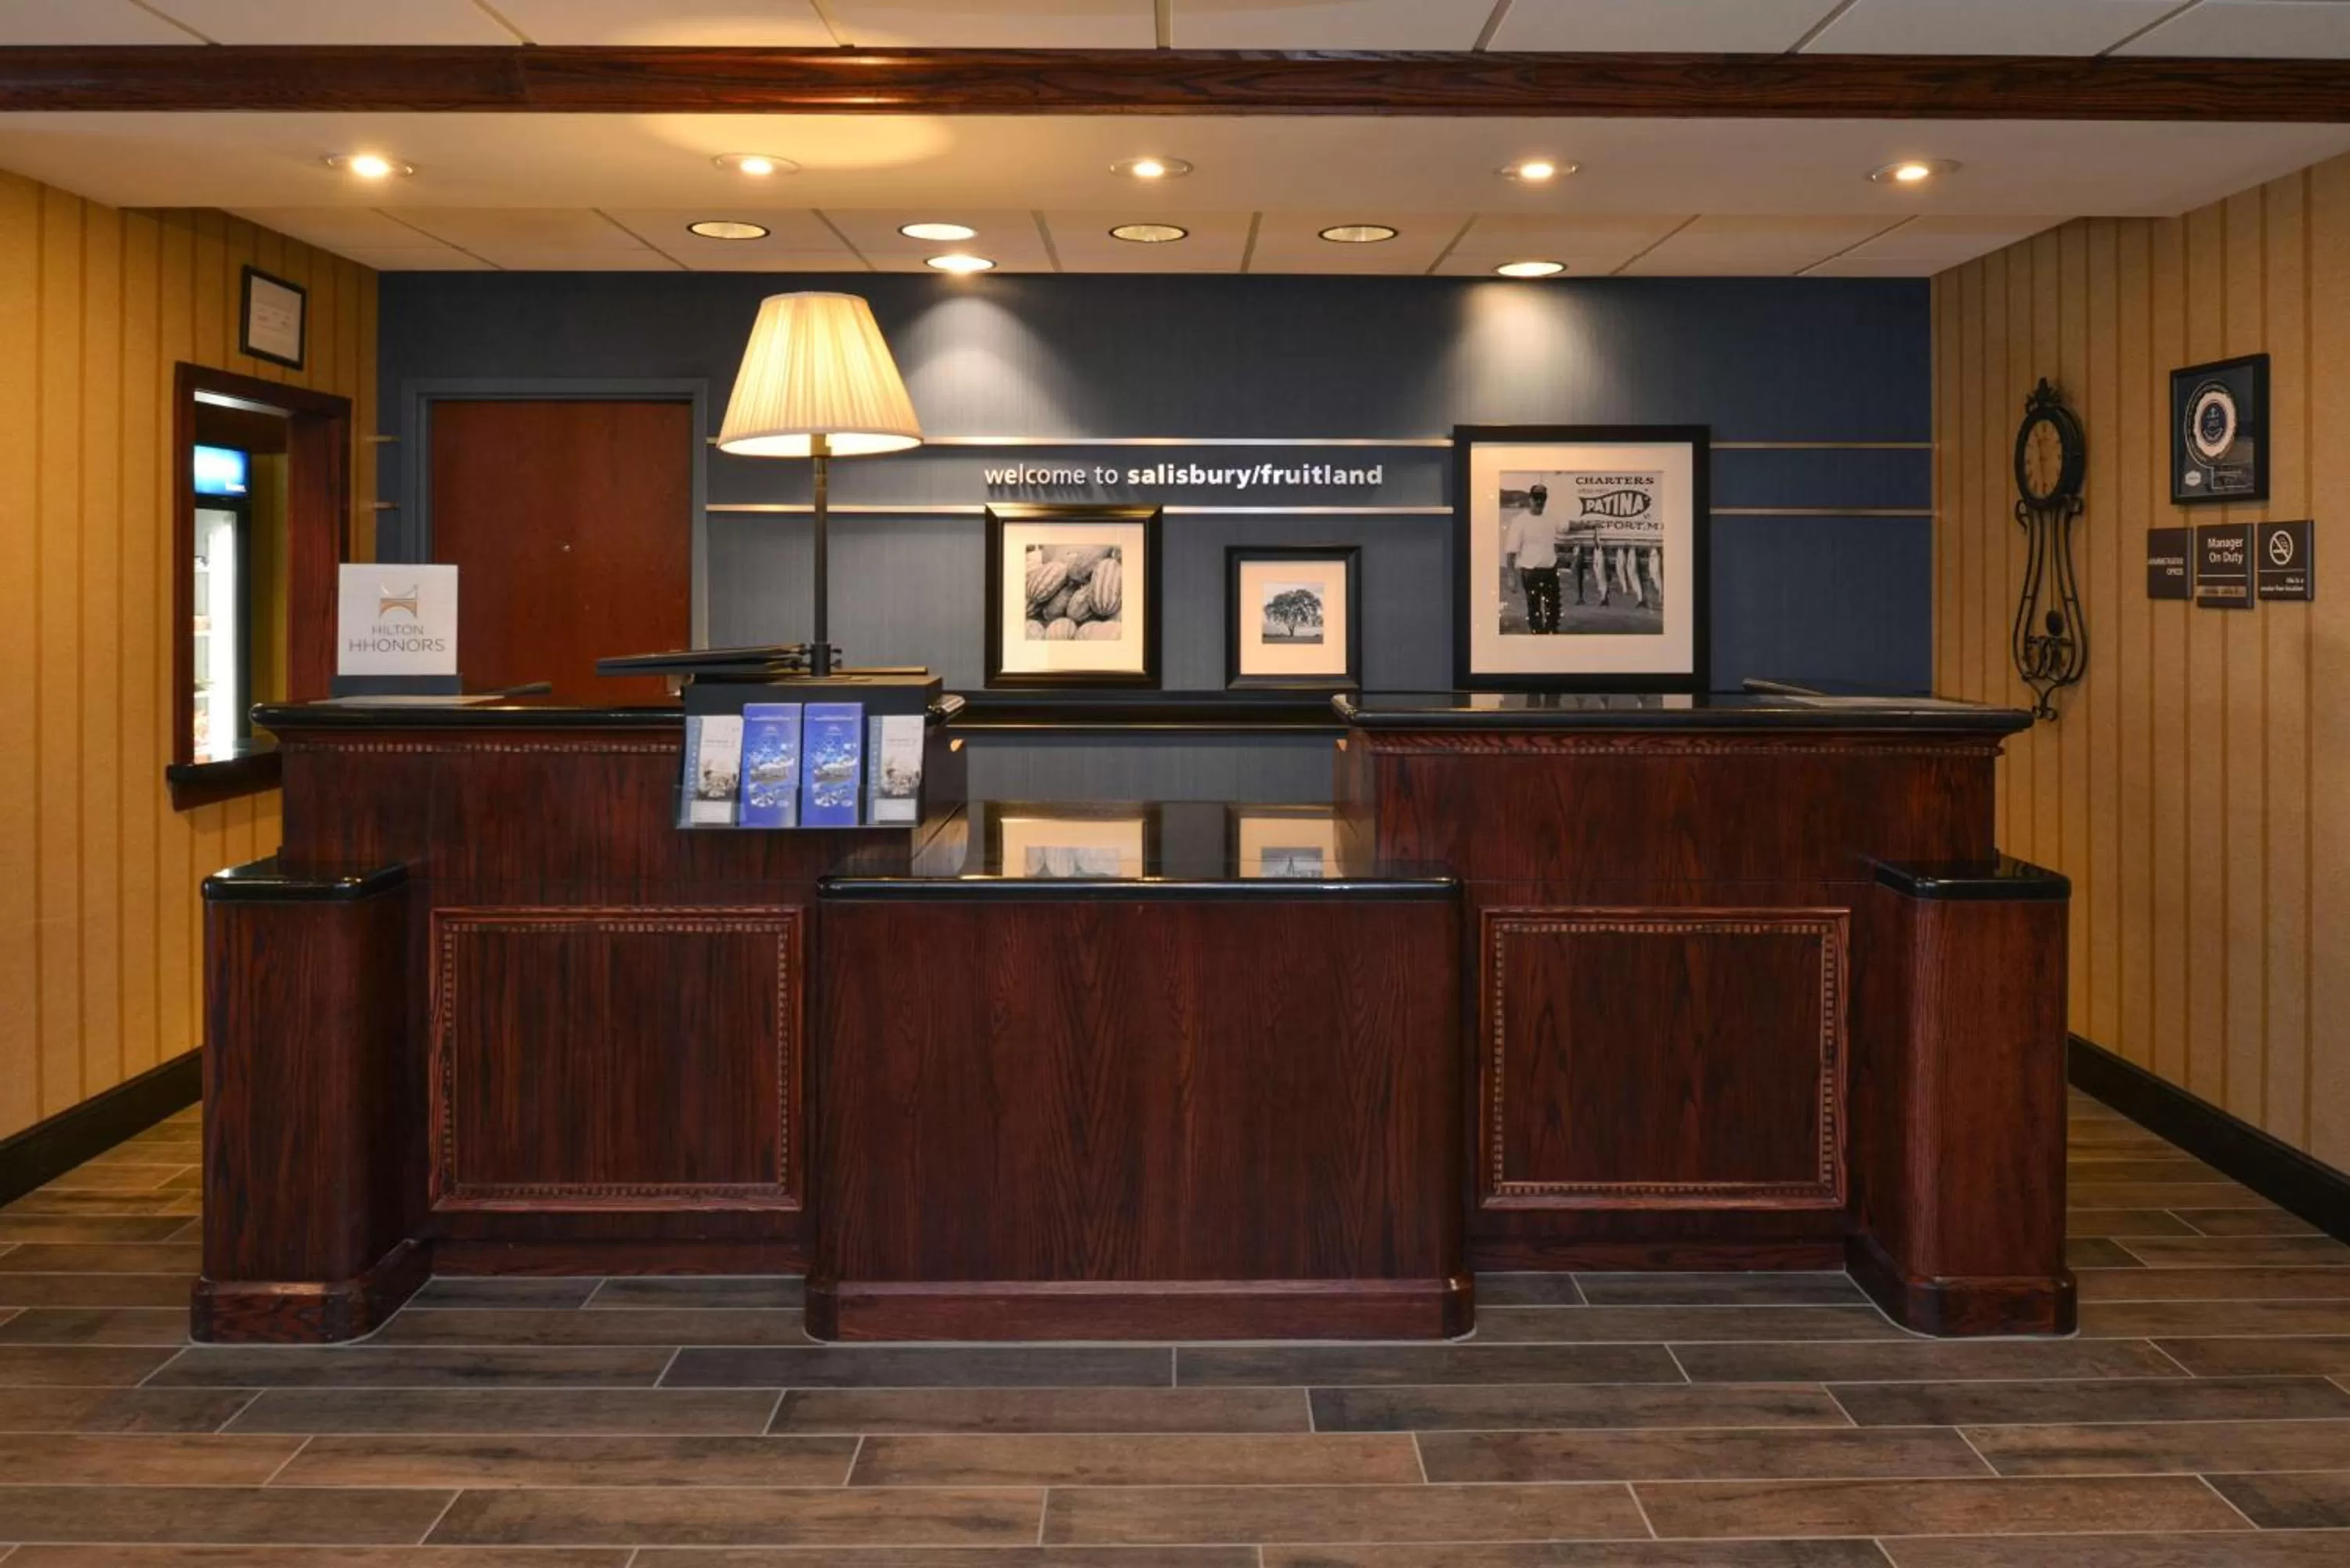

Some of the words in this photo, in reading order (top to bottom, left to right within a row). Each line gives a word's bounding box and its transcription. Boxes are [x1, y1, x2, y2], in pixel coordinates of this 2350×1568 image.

[984, 464, 1086, 485] welcome
[1094, 466, 1119, 485] to
[1127, 464, 1383, 490] salisbury/fruitland
[1575, 475, 1655, 485] CHARTERS
[1585, 492, 1644, 515] PATINA
[2207, 537, 2244, 550] Manager
[2209, 551, 2221, 564] On
[2223, 551, 2244, 565] Duty
[371, 625, 425, 635] HILTON
[349, 638, 446, 652] HHONORS
